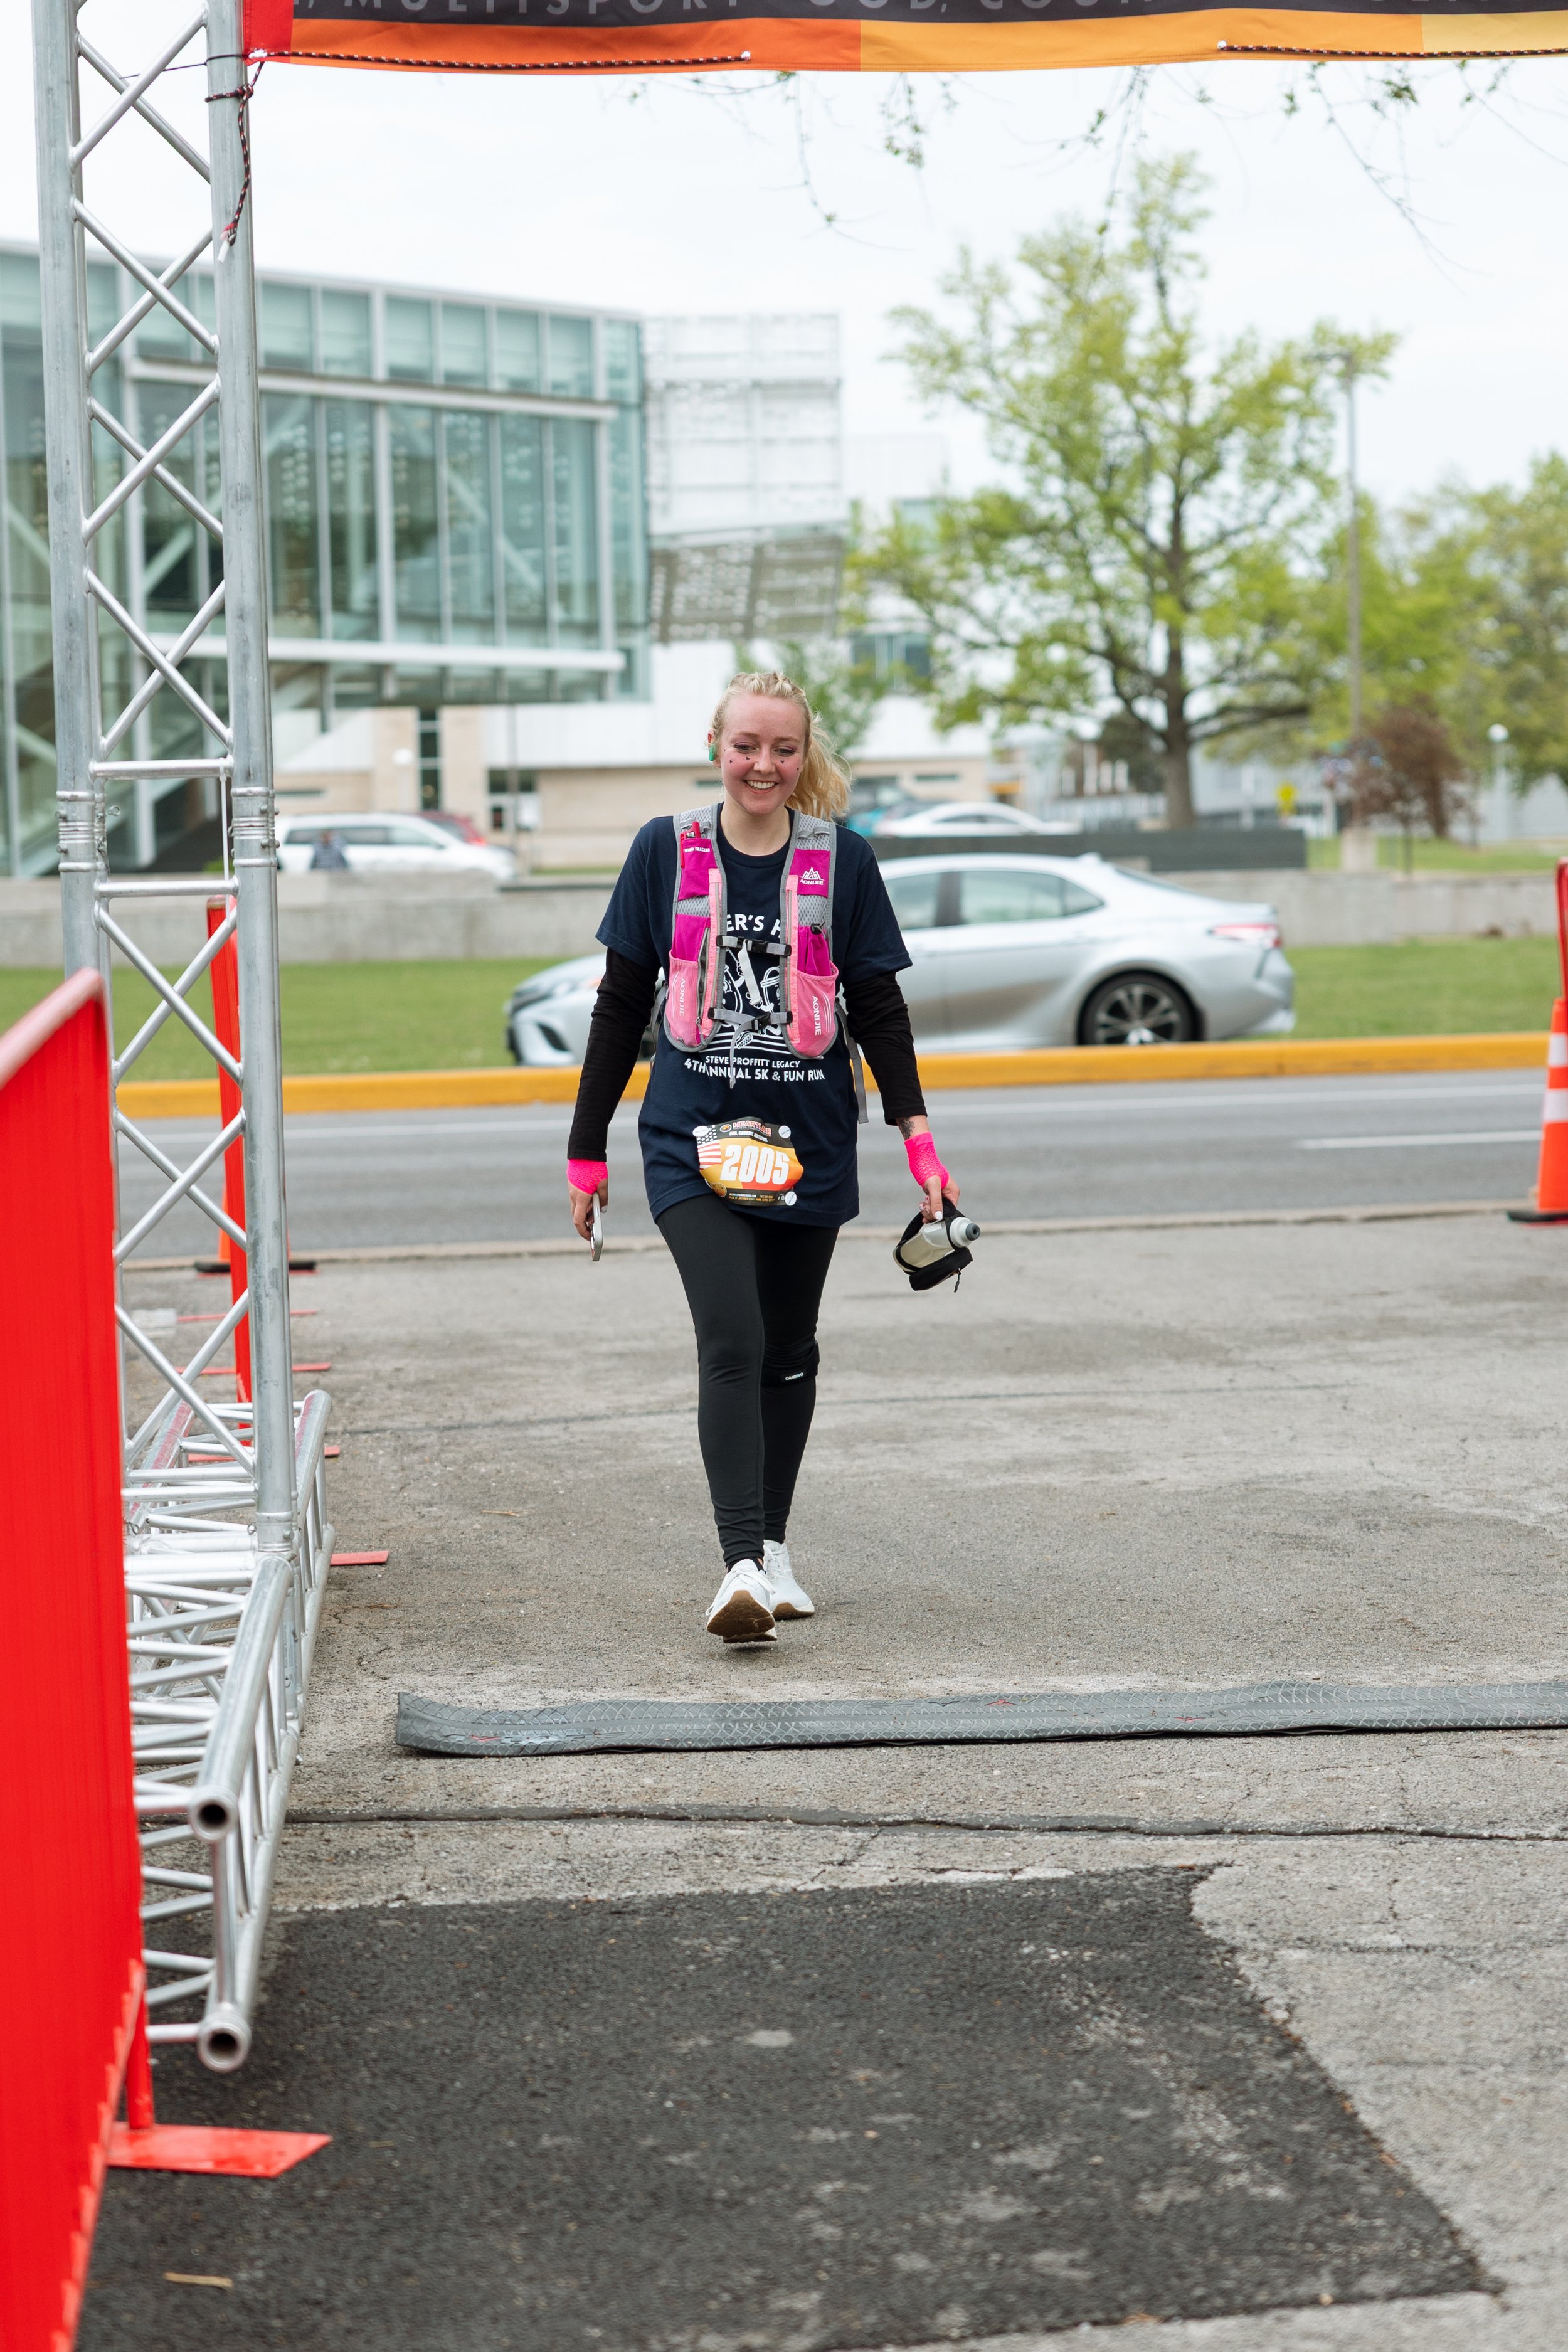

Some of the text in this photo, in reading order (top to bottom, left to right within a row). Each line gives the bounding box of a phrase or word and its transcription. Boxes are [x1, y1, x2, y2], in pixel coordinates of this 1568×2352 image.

[812, 995, 822, 1036] AONIJIE
[684, 1058, 825, 1082] 4TH NNUAL 5K & FUN RUN
[705, 1055, 729, 1064] STEVE
[771, 1060, 800, 1069] LEGACY
[719, 1144, 790, 1185] 2005
